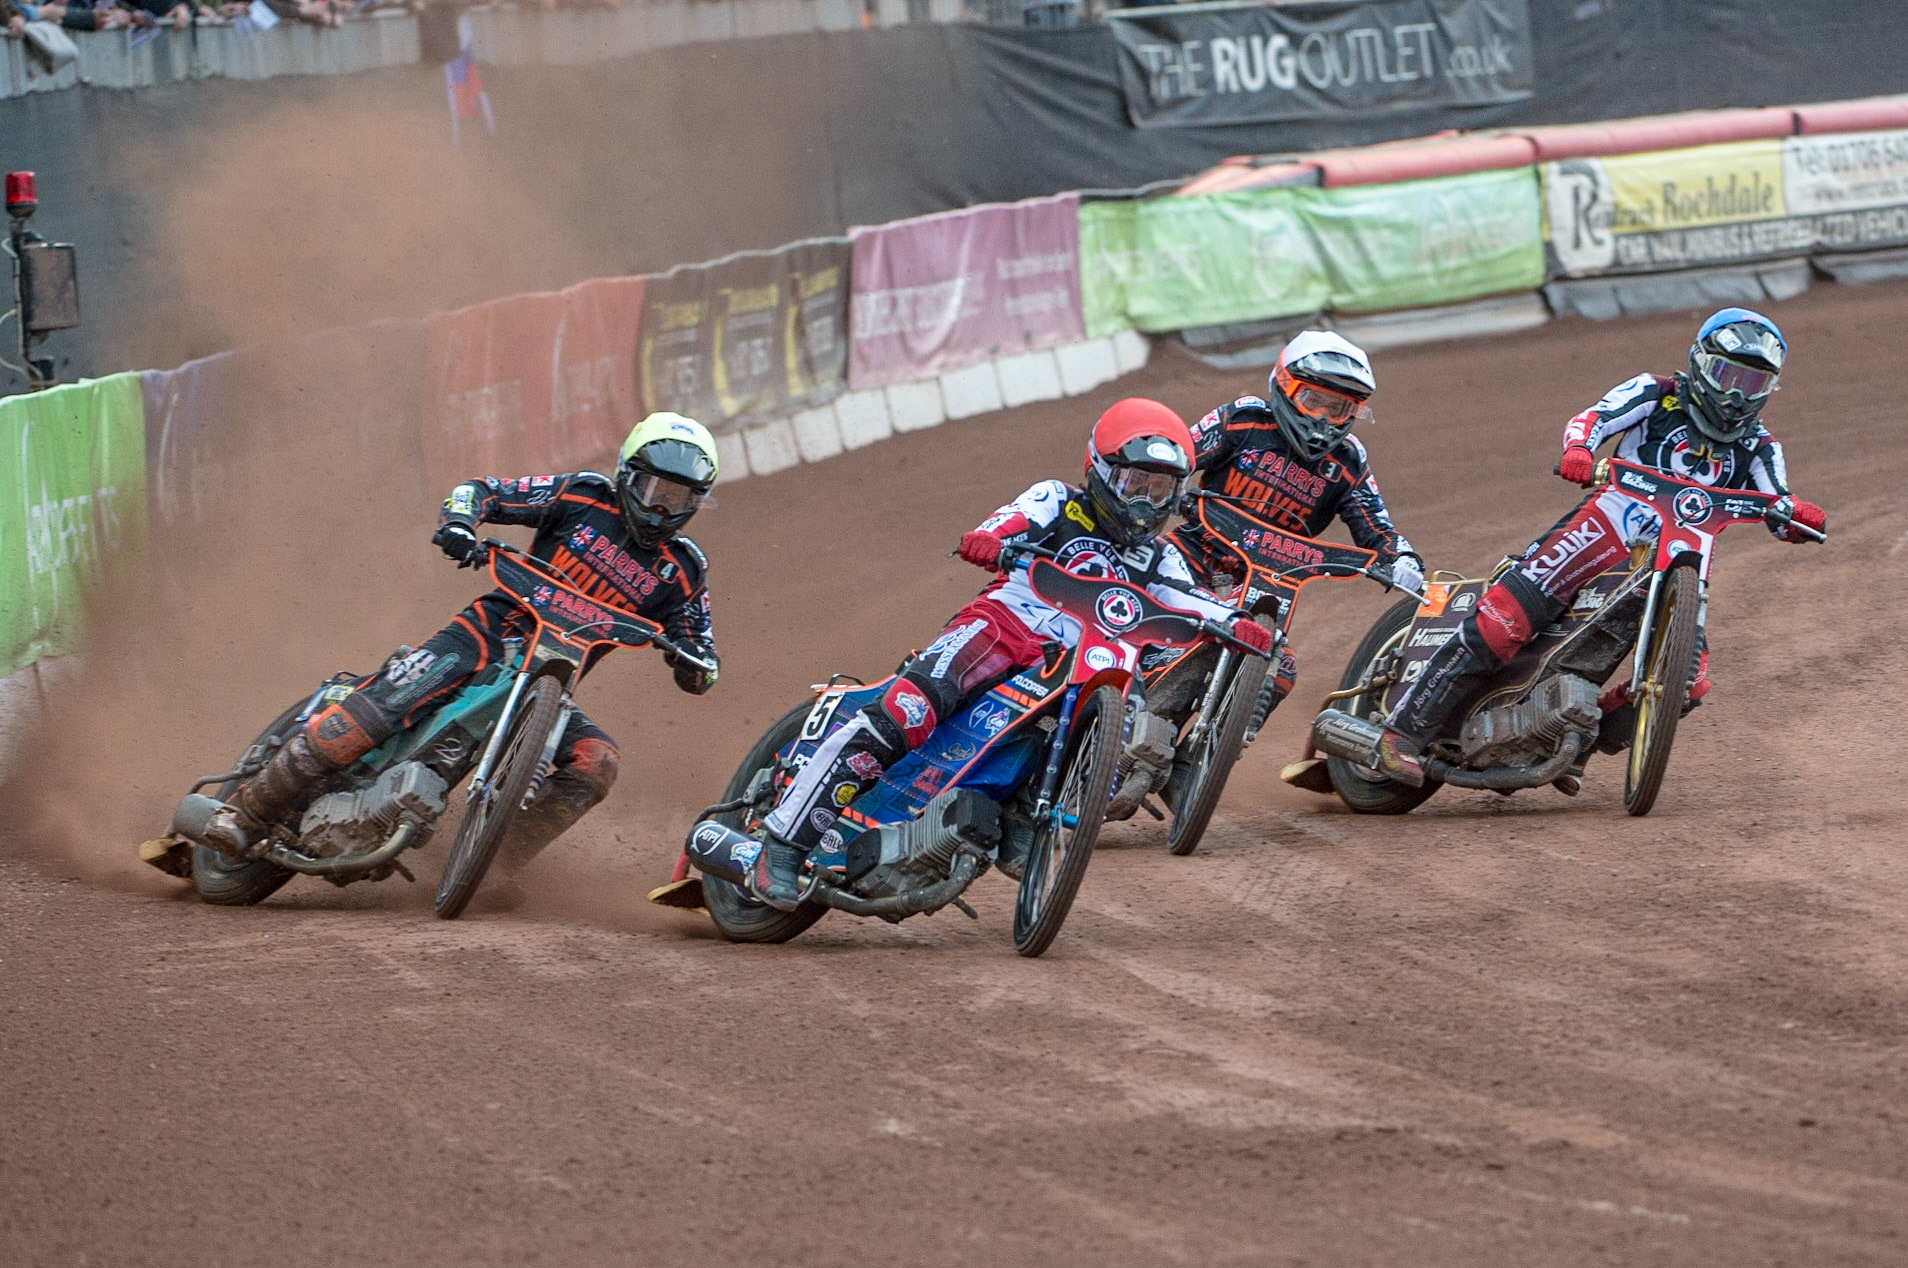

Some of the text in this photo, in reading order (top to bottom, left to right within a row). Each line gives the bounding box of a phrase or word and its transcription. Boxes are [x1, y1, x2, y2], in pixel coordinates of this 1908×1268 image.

[1137, 40, 1204, 99] THE
[1211, 35, 1297, 93] RUG
[1662, 171, 1776, 224] Rochdale
[1258, 451, 1326, 498] PARRYS
[1325, 462, 1337, 478] 3
[1223, 467, 1312, 531] WOLVES
[590, 535, 660, 596] PARRYS
[1067, 540, 1095, 556] BELLE
[1100, 543, 1117, 563] VUE
[1261, 532, 1324, 565] PARRYS
[583, 551, 645, 605] INTERNATIONAL
[660, 562, 674, 580] 4
[551, 590, 614, 632] PARRYS
[1101, 590, 1117, 601] BELLE
[1091, 653, 1110, 665] ATPI
[805, 694, 840, 738] 5
[699, 828, 721, 843] ATPI
